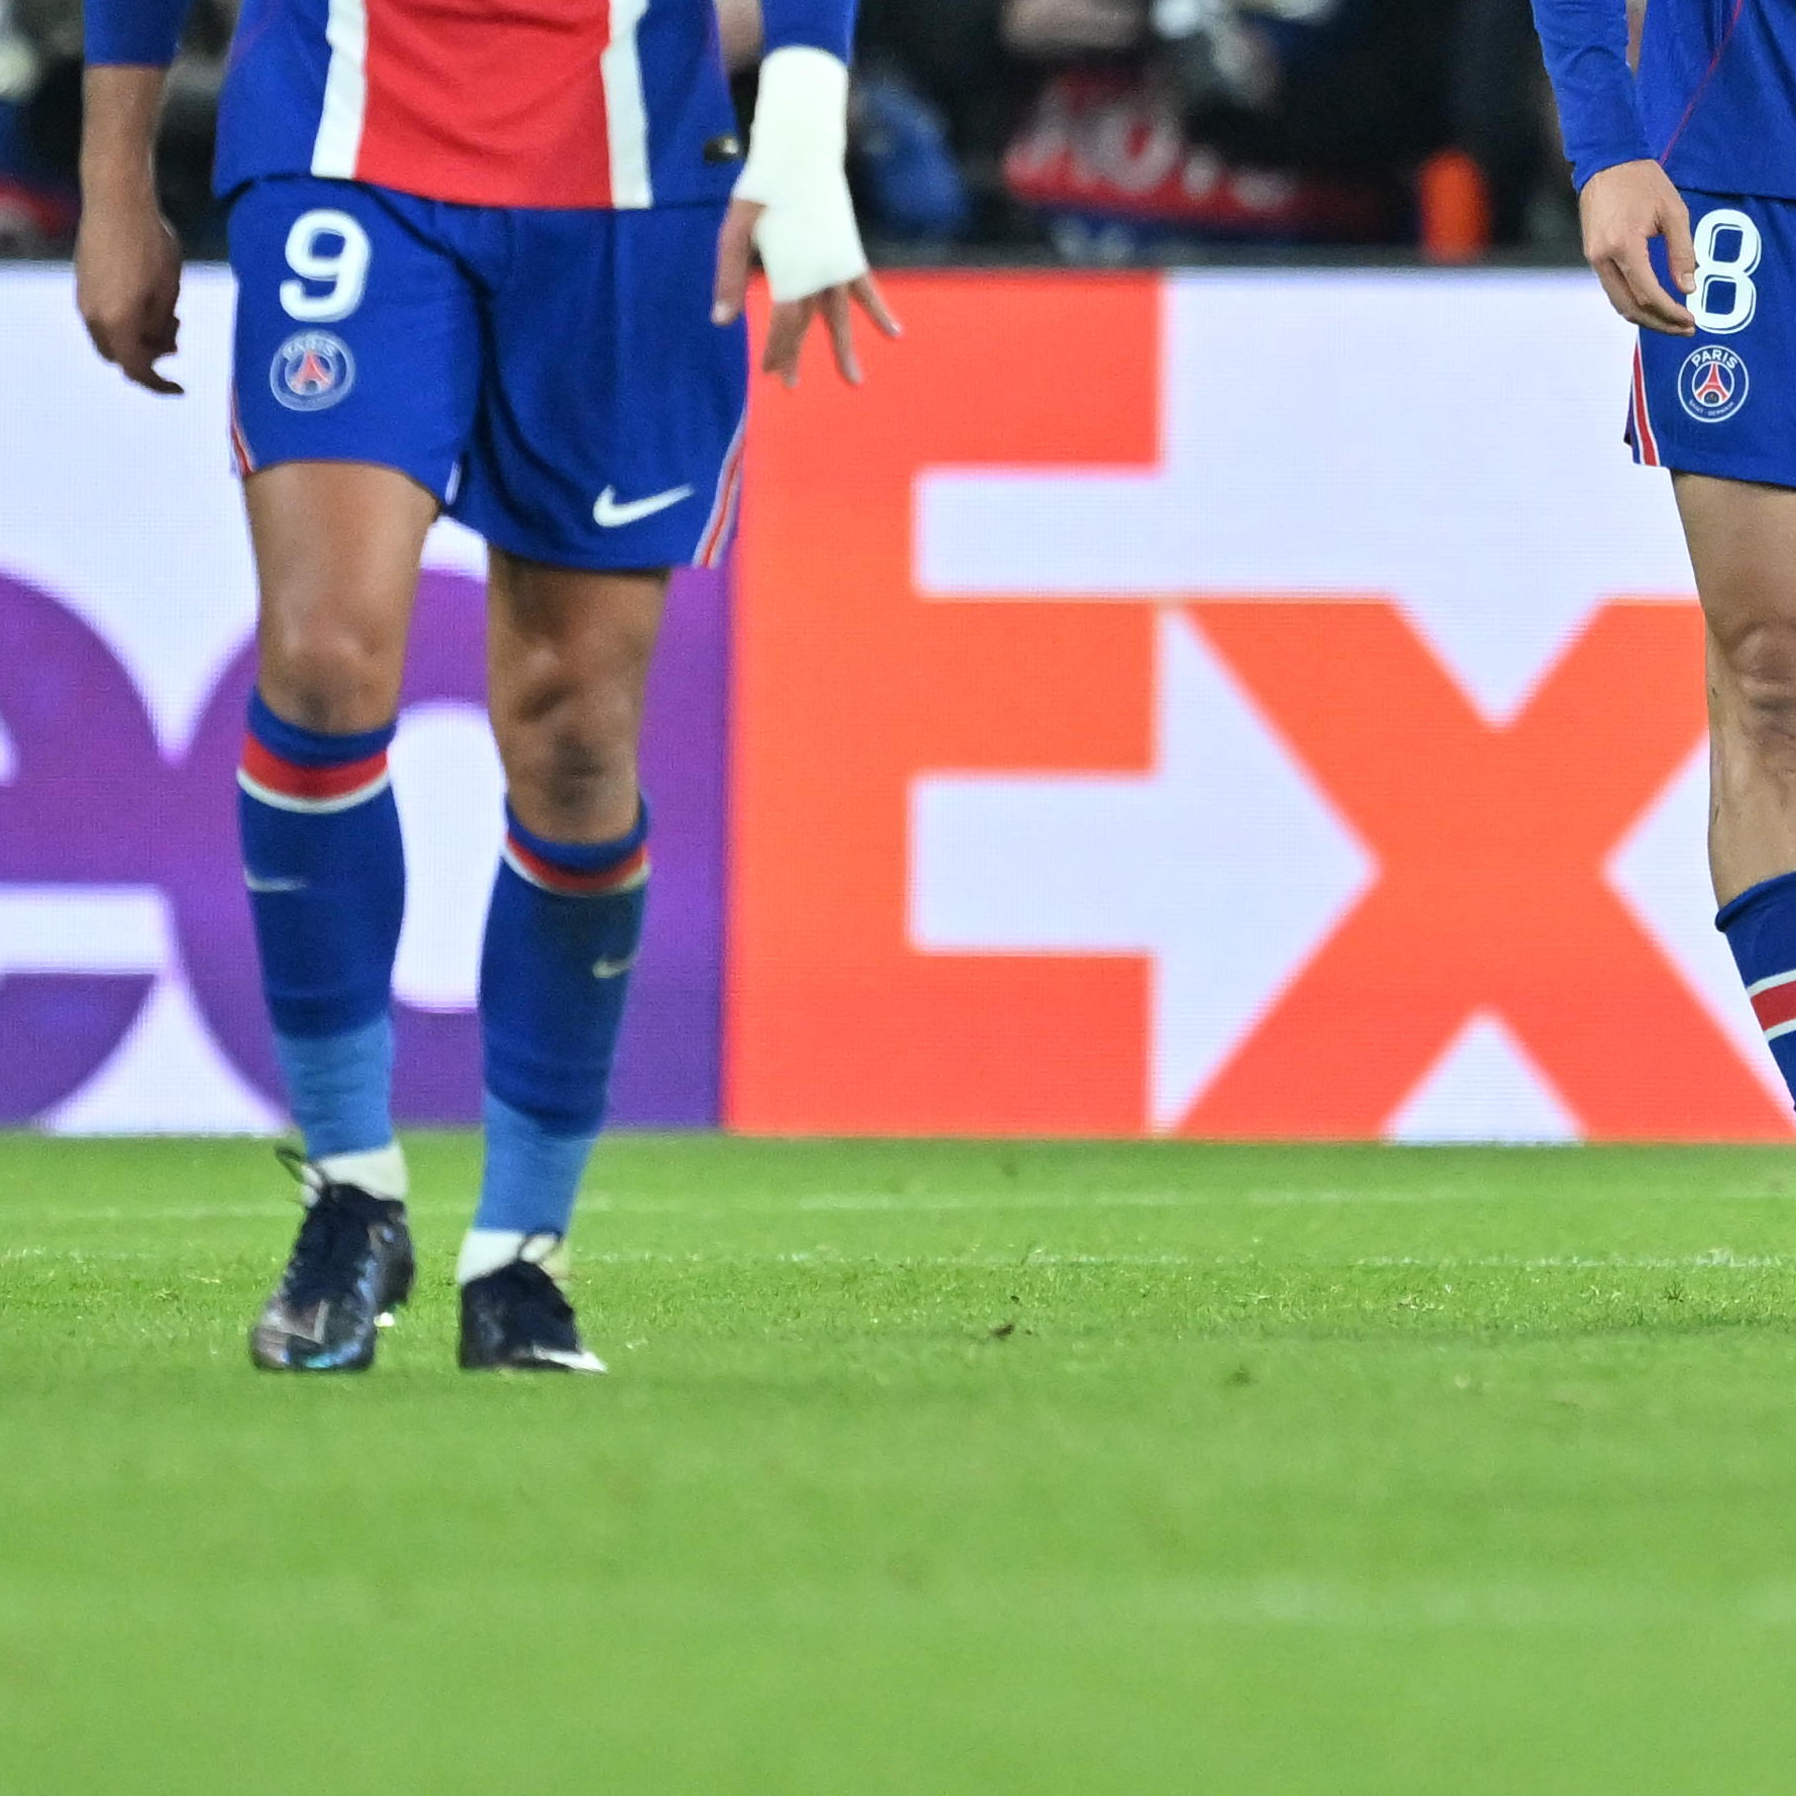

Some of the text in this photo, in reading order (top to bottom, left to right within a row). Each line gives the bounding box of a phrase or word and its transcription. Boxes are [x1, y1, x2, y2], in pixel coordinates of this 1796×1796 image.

[279, 208, 372, 323] 9
[1686, 208, 1762, 335] 8
[1691, 349, 1738, 370] PARIS
